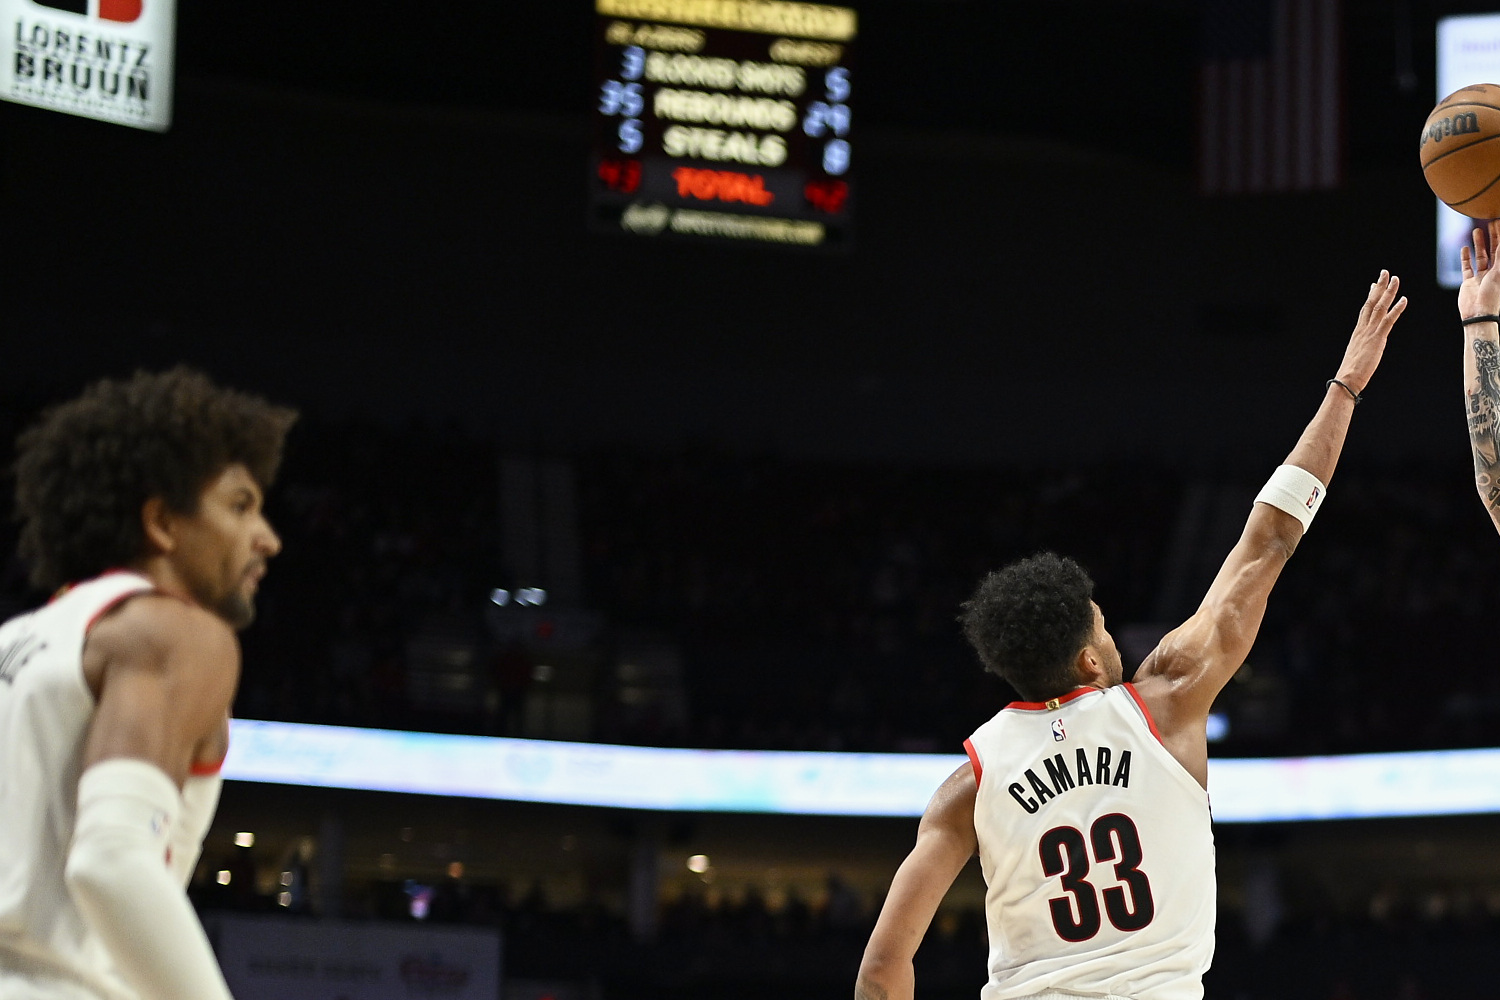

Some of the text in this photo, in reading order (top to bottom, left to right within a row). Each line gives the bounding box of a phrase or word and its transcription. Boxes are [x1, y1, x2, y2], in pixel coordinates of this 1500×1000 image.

[15, 20, 150, 67] LORENTZ
[15, 51, 148, 100] BRUUN
[654, 87, 797, 130] REBOUNDS
[663, 124, 788, 167] STEALS
[672, 166, 774, 207] TOTAL
[1008, 746, 1132, 814] CAMARA
[1038, 812, 1156, 943] 33
